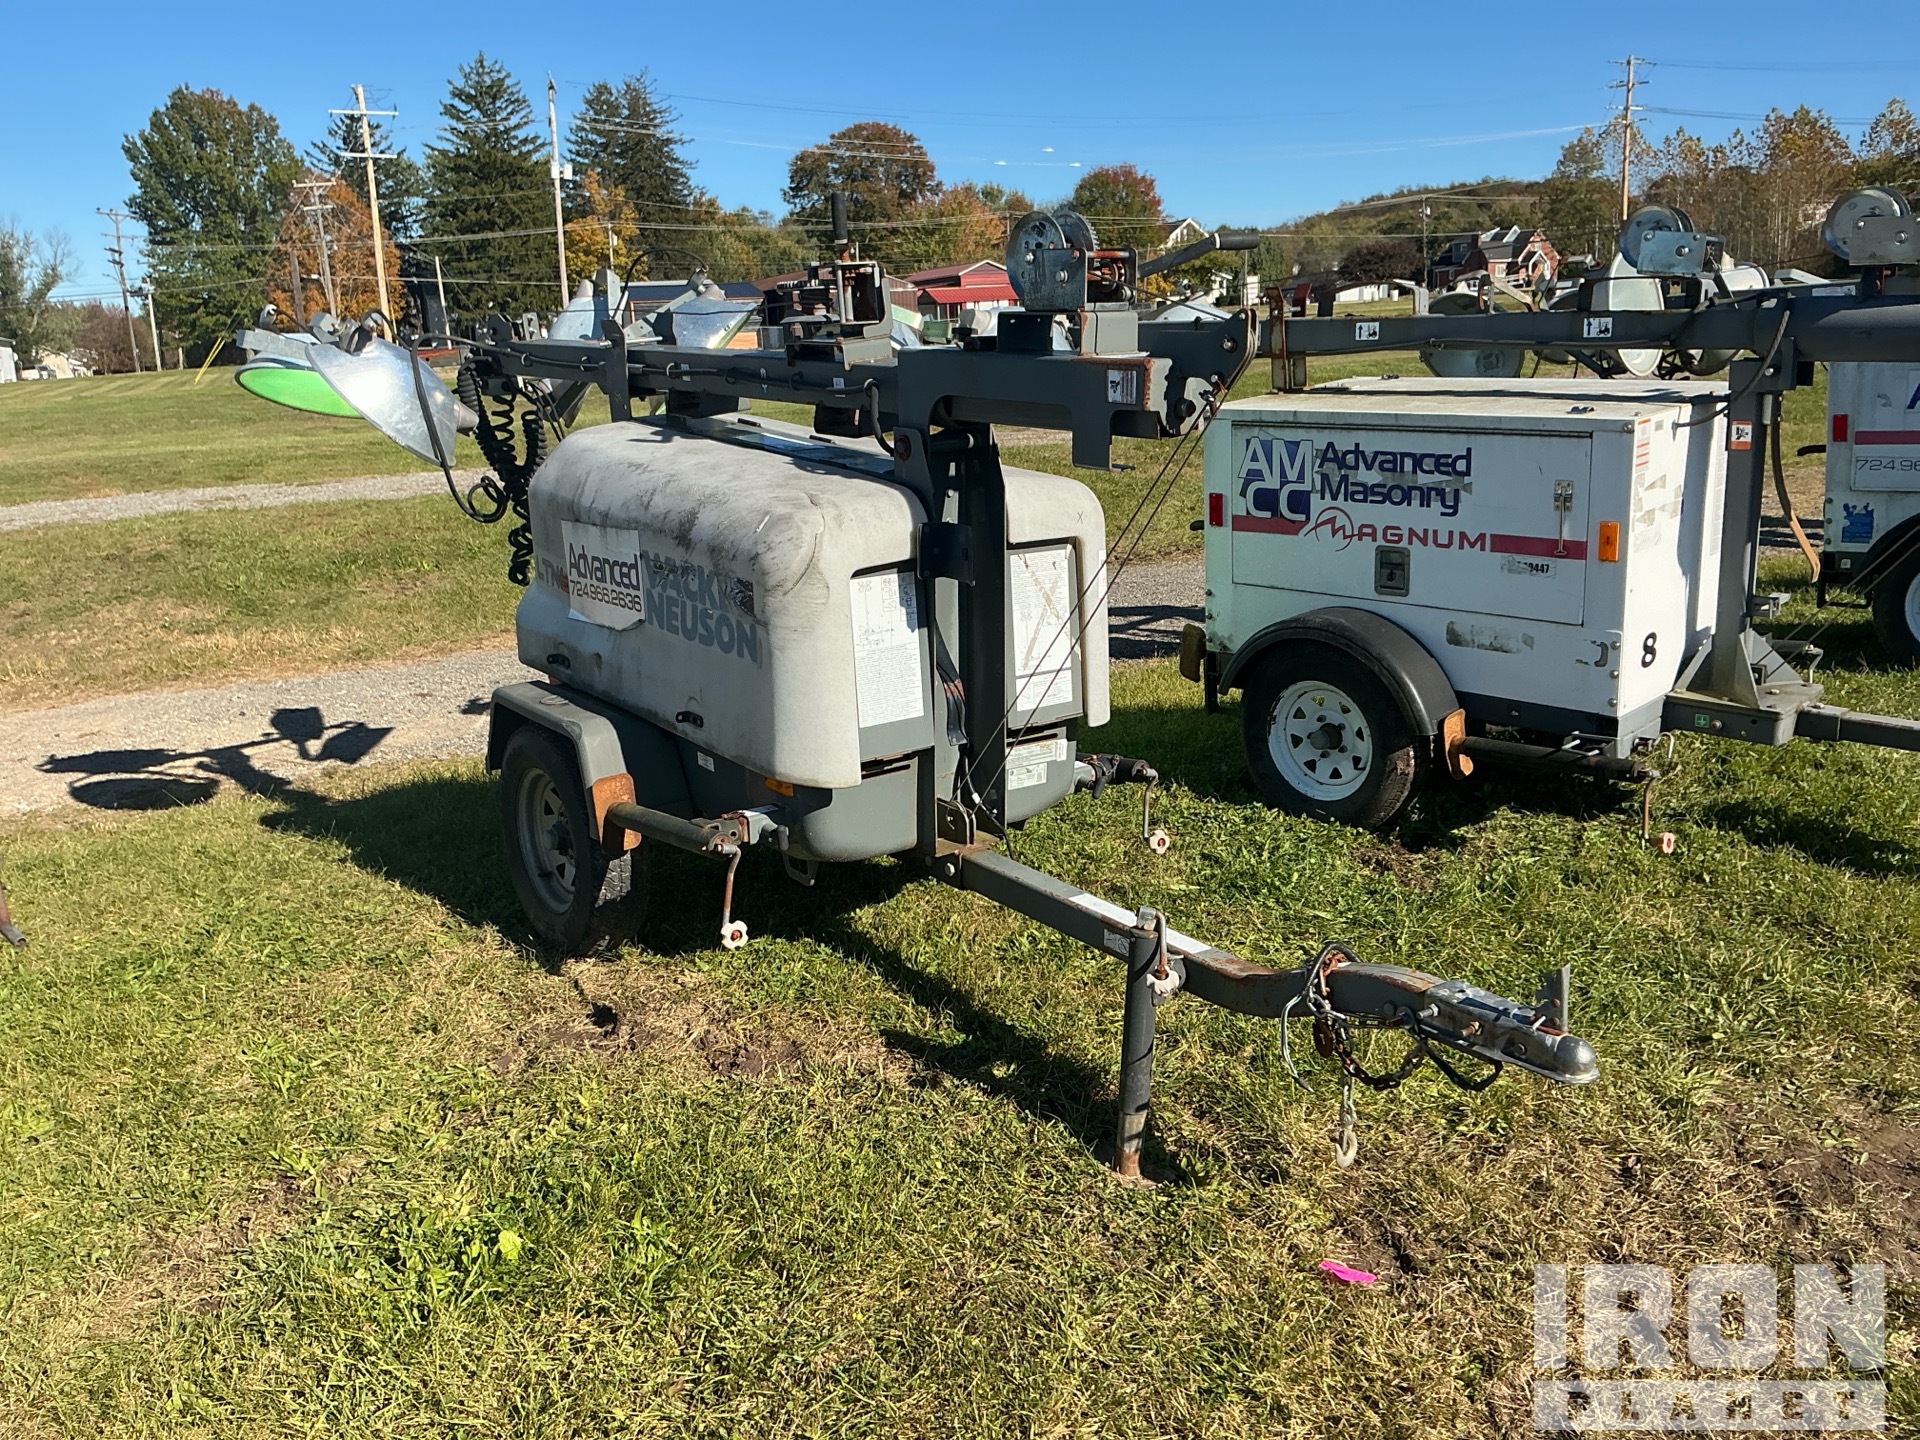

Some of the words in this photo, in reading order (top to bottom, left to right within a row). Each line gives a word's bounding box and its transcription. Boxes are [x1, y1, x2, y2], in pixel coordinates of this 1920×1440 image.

[1318, 441, 1472, 477] Advanced
[1320, 472, 1460, 517] Masonry
[569, 543, 640, 591] Advanced
[646, 588, 757, 663] NEUSON
[1641, 632, 1657, 668] 8
